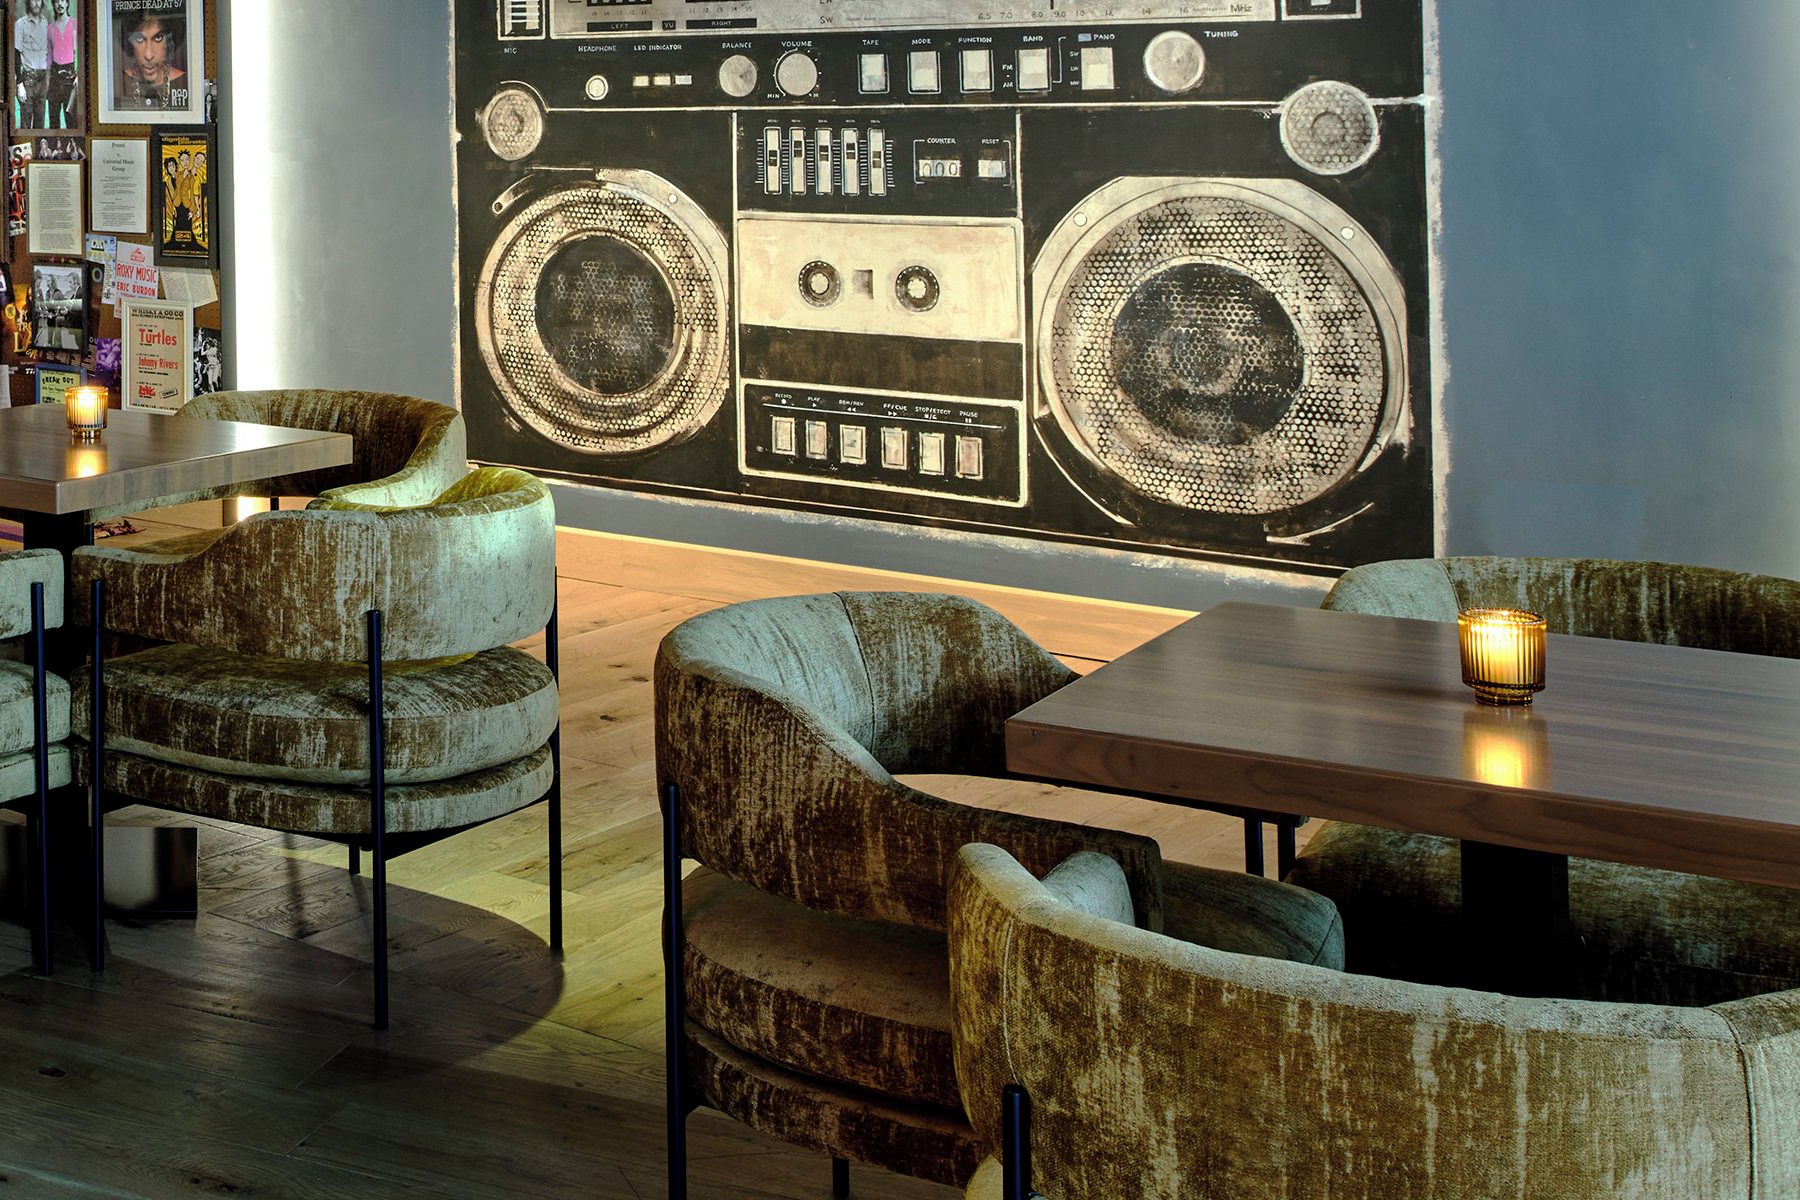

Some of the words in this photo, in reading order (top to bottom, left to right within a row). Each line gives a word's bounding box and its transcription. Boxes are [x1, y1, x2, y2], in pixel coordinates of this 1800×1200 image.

[115, 0, 141, 10] PRINCE
[142, 0, 163, 9] DEAD
[163, 0, 173, 8] AT
[174, 0, 183, 7] 57
[820, 16, 834, 24] SW
[978, 12, 991, 20] 6.5
[1231, 4, 1252, 12] MHz
[1203, 30, 1239, 38] TUNING
[116, 262, 134, 279] ROXY
[136, 267, 157, 283] MUSIC
[117, 281, 129, 291] ERIC
[132, 284, 156, 297] BURDON
[132, 308, 157, 316] WHISKY
[139, 329, 177, 346] Turtles
[138, 356, 158, 369] Johnny
[159, 358, 178, 369] Rivers
[883, 403, 907, 411] FF/CUE
[960, 410, 978, 418] PAUSE
